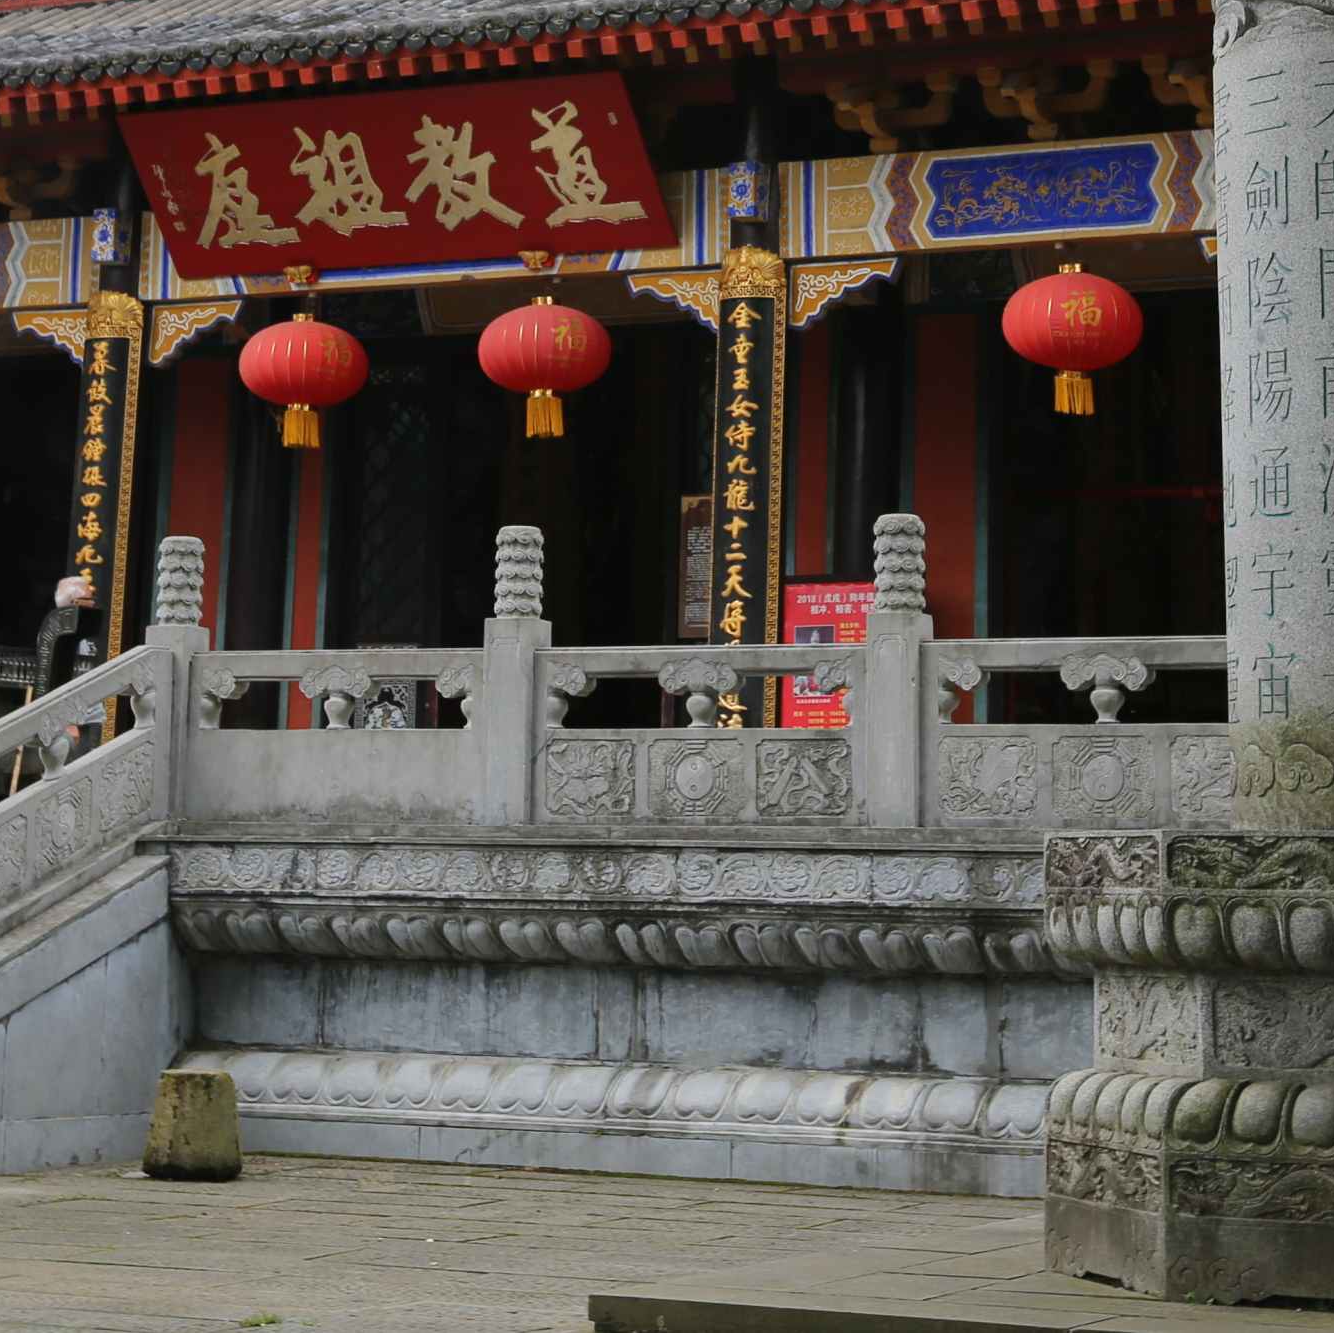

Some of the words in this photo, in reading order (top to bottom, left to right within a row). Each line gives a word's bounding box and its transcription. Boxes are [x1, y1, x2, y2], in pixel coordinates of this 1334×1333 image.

[195, 101, 647, 250] 道教祖庭
[318, 334, 353, 366] 福
[550, 317, 588, 352] 福
[1061, 291, 1103, 327] 福
[1244, 68, 1296, 720] 三劍陰陽通宇宙
[720, 301, 762, 645] 金童玉女侍九龍十二天將
